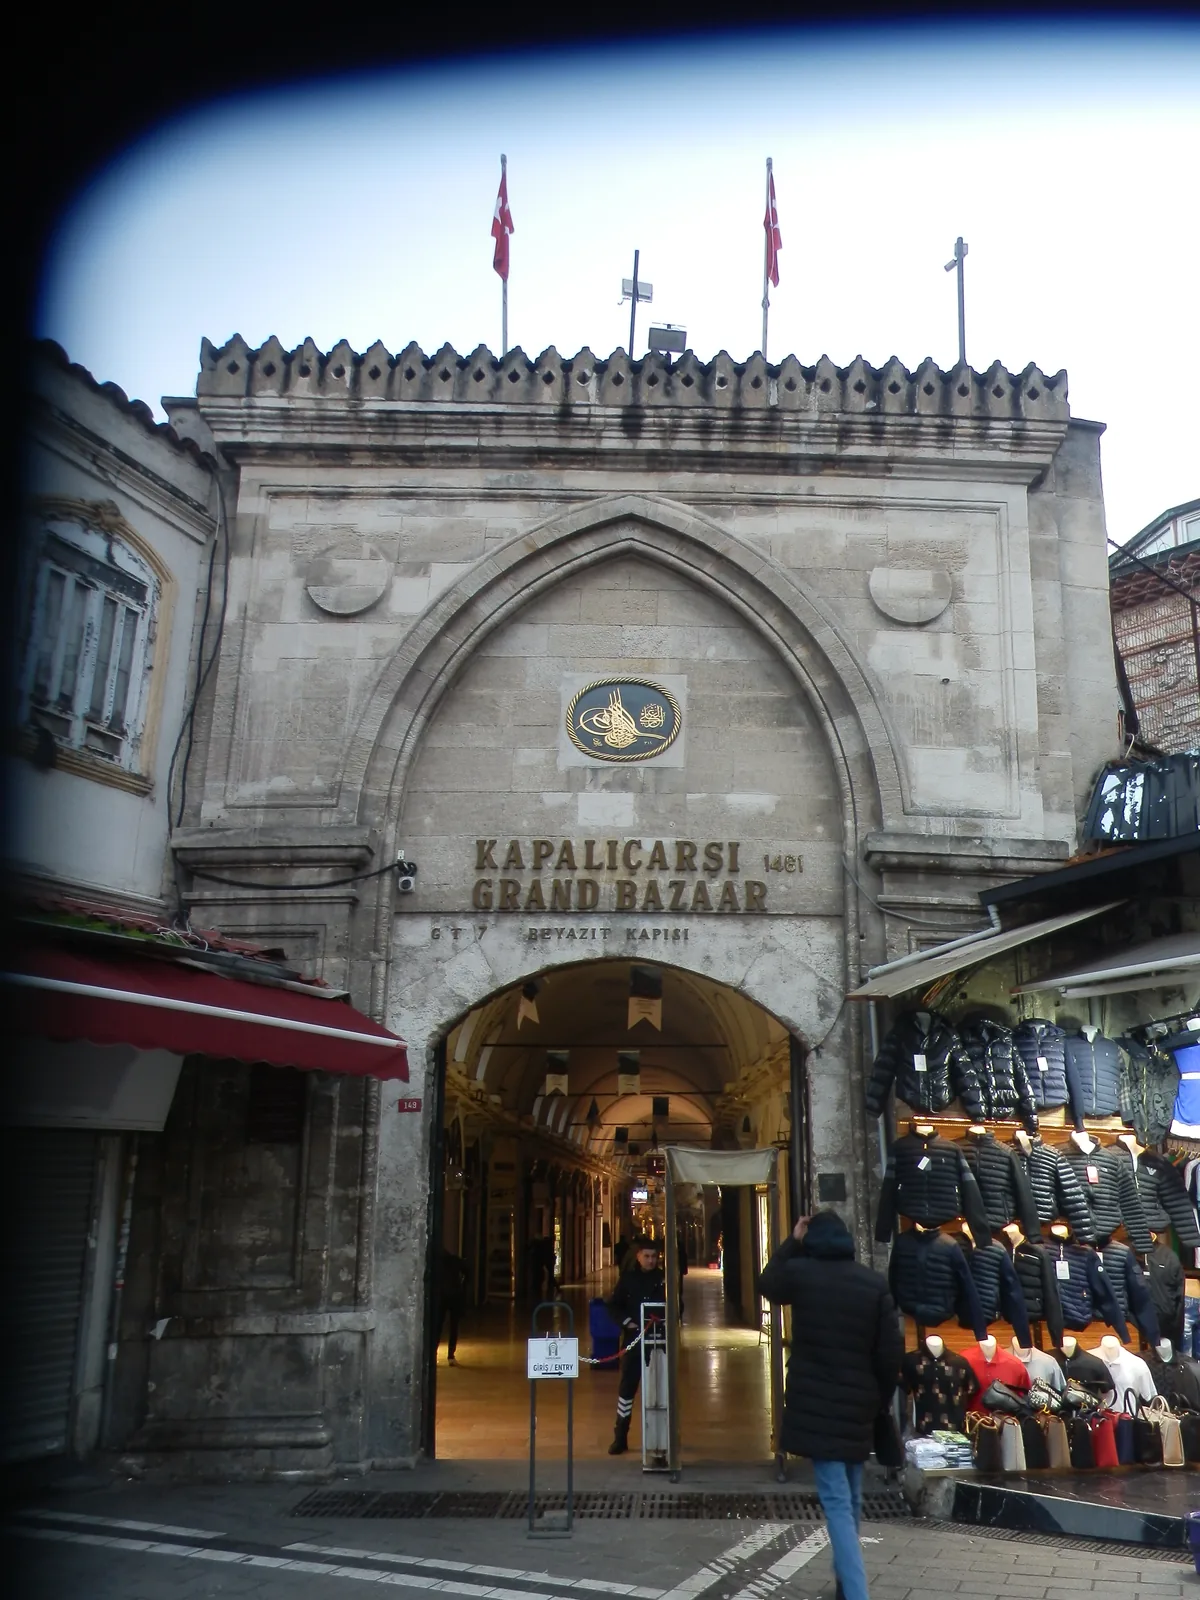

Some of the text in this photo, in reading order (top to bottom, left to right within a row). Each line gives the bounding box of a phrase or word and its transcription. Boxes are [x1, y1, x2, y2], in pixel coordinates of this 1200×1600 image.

[475, 839, 740, 878] KAPALIÇARŞI
[763, 854, 804, 873] 1461
[472, 878, 768, 911] GRAND BAZAAR
[478, 925, 488, 940] 7
[528, 927, 689, 941] BEYAZIT KAPISI
